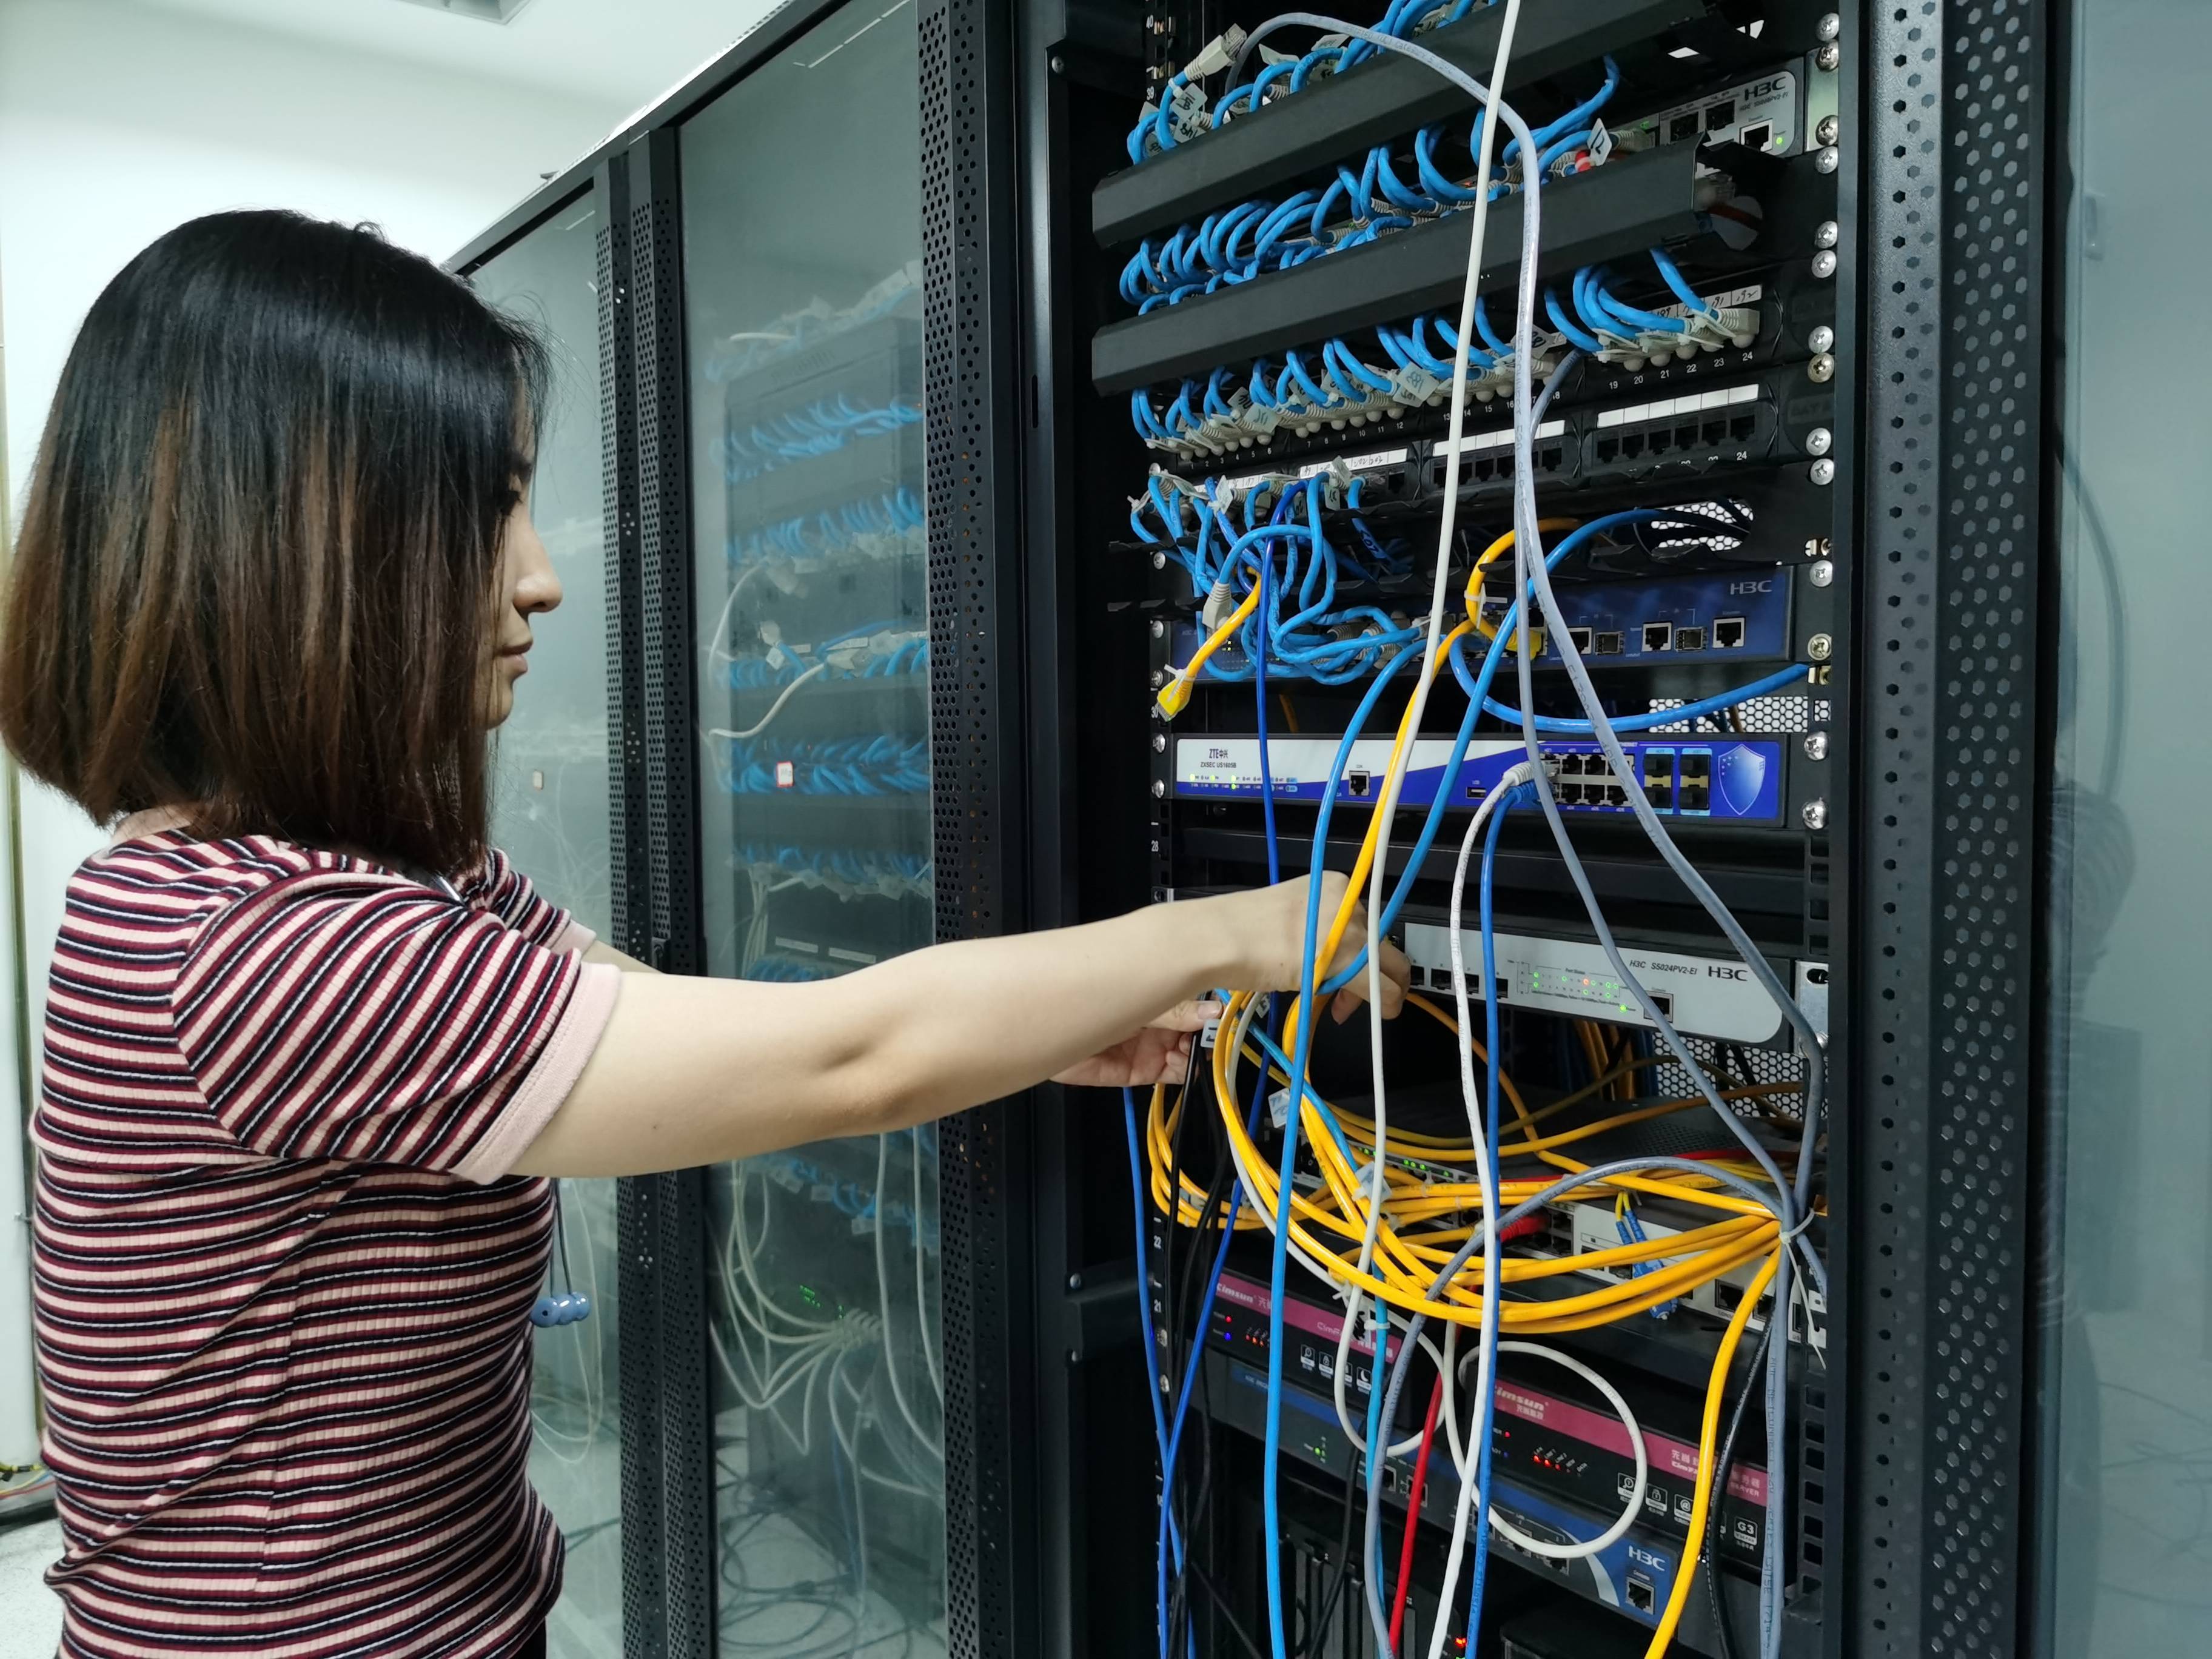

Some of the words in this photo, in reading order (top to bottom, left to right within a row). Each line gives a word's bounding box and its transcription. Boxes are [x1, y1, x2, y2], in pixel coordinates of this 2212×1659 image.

[1744, 76, 1786, 101] H3C
[1609, 381, 1618, 390] 19
[1634, 375, 1644, 384] 20
[1660, 370, 1669, 379] 21
[1686, 364, 1697, 373] 22
[1714, 358, 1724, 367] 23
[1742, 351, 1753, 361] 24
[1736, 451, 1747, 461] 24
[1730, 580, 1772, 595] H3C
[1151, 840, 1159, 853] 28
[1629, 960, 1647, 968] H3C
[1651, 962, 1697, 975] S5024PV2-EI
[1708, 966, 1748, 982] H3C
[1154, 1235, 1162, 1249] 22
[1216, 1282, 1254, 1303] Cimsun
[1154, 1299, 1162, 1313] 21
[1495, 1386, 1544, 1412] imsun
[1737, 1521, 1754, 1535] G3
[1628, 1545, 1665, 1572] H3C
